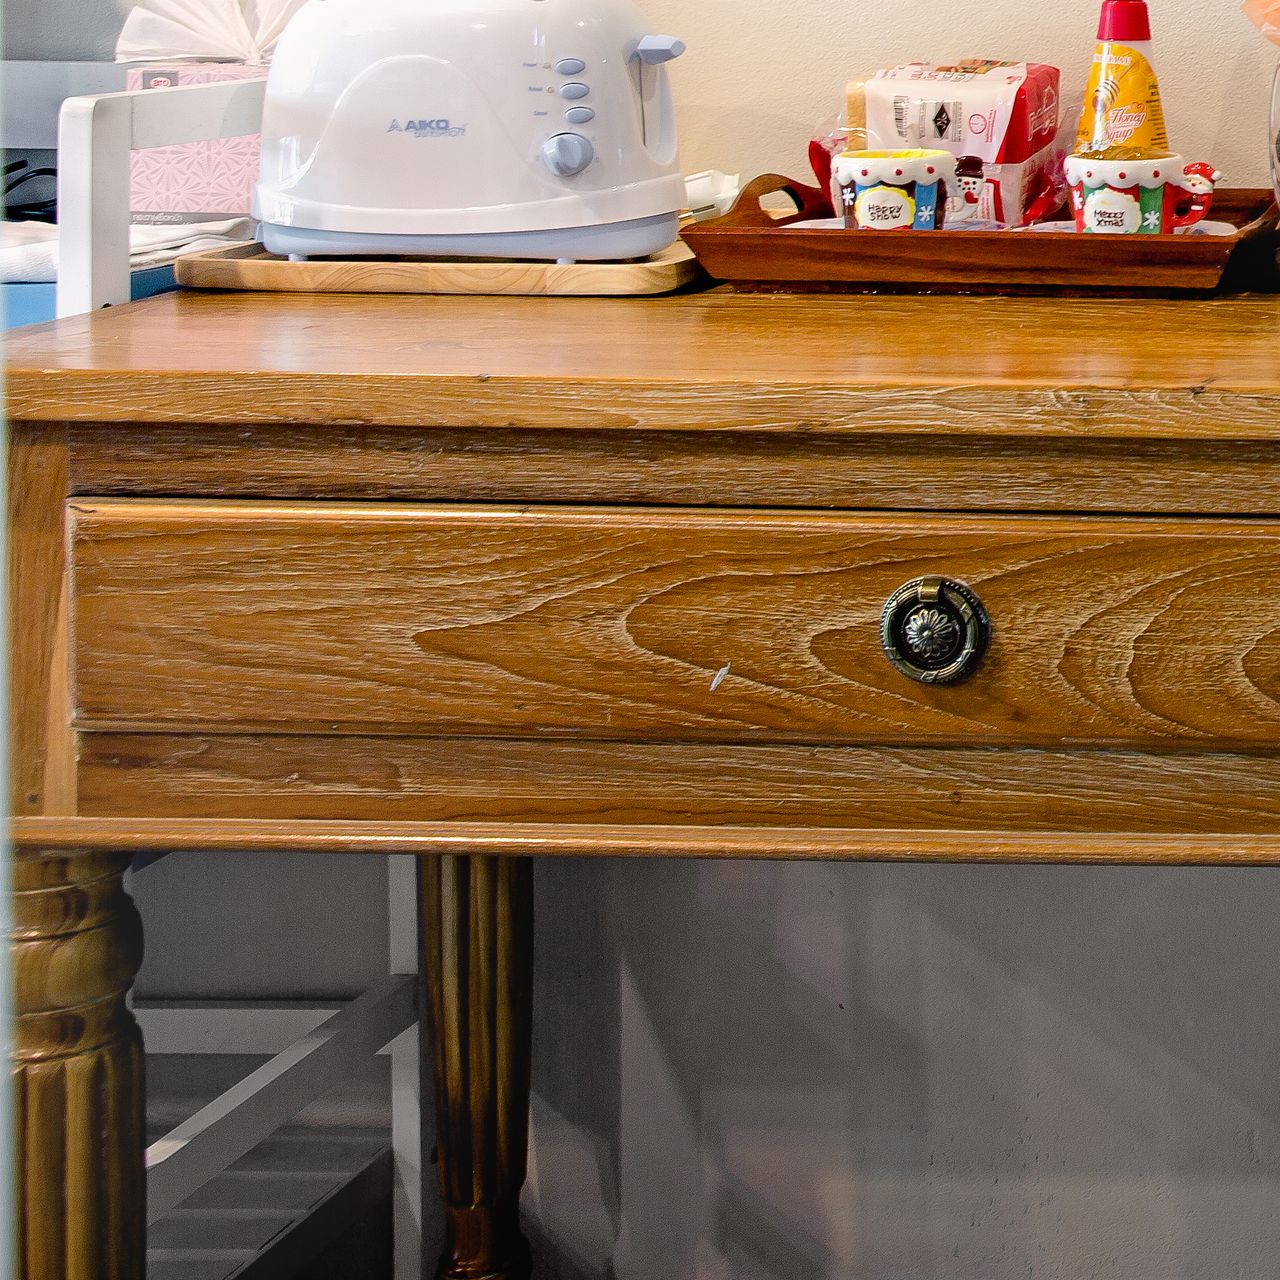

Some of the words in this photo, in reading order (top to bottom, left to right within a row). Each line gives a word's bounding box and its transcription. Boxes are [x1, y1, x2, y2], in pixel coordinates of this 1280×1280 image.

[1109, 105, 1145, 124] Honey
[868, 203, 903, 214] Happy
[1096, 218, 1124, 227] Xmas
